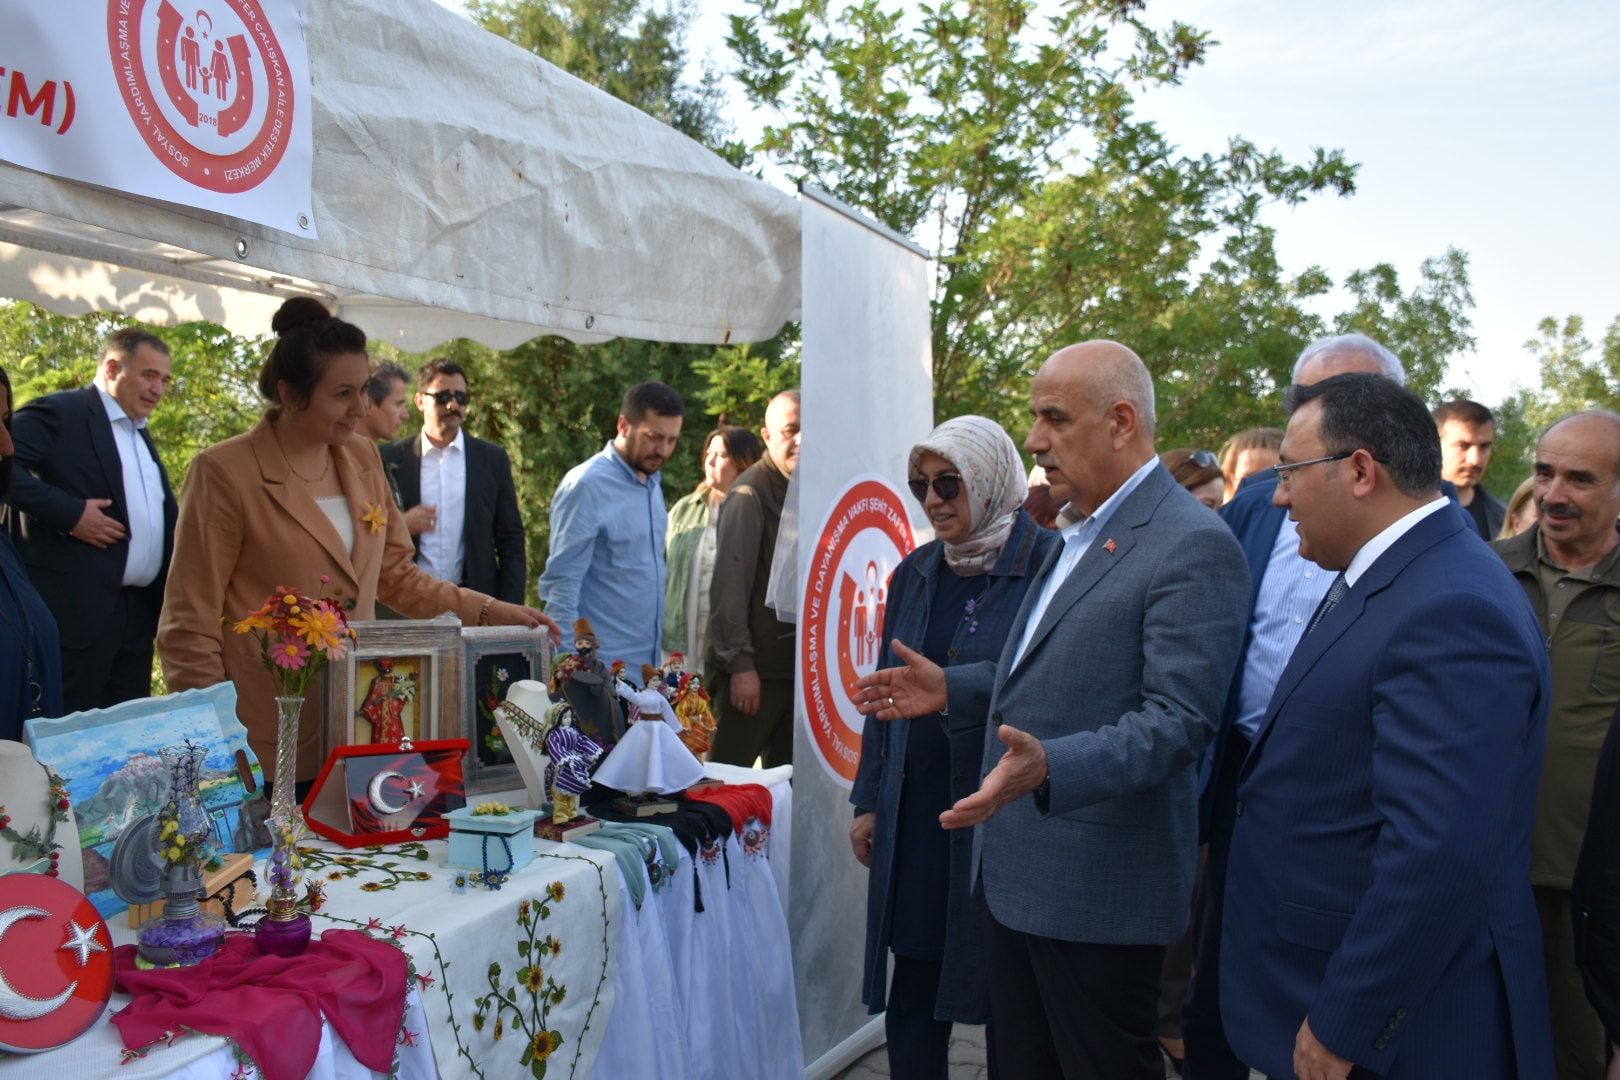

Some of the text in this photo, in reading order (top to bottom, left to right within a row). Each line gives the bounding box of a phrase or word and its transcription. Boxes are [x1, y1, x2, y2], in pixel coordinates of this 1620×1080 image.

[118, 20, 152, 126] YARDIMLAŞMA
[255, 22, 285, 87] ÇALIŞKAN
[199, 113, 217, 127] 2018
[277, 89, 287, 118] AİLE
[153, 124, 189, 167] SOSYAL
[260, 119, 282, 160] DESTEK
[810, 596, 821, 619] VE
[809, 624, 832, 739] YARDIMLAŞMA
[832, 732, 858, 764] SOSYAL
